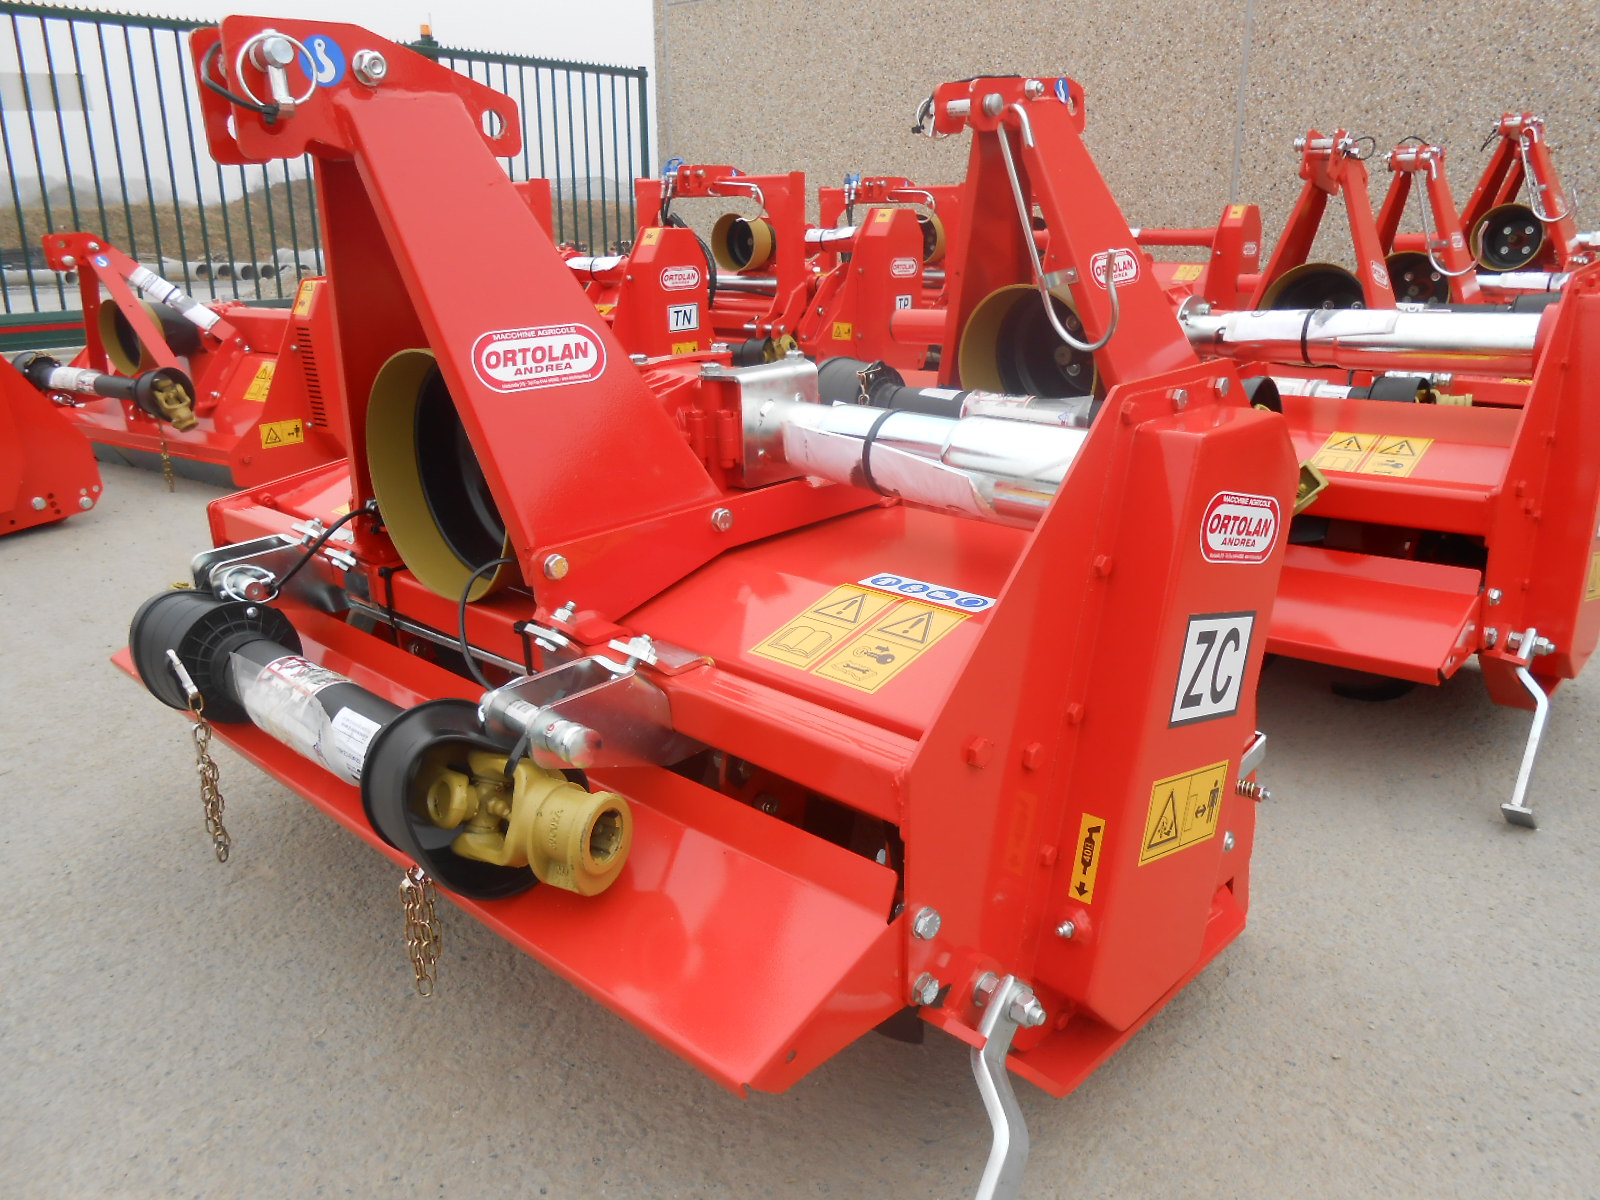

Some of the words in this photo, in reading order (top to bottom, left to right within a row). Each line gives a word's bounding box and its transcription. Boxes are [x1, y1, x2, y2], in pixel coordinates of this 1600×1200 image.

[663, 273, 696, 282] ORTOLAN
[898, 297, 909, 310] TP
[673, 309, 692, 327] TN
[492, 329, 537, 341] MACCHINE
[537, 326, 577, 337] AGRICOLE
[485, 341, 589, 370] ORTOLAN
[514, 362, 573, 376] ANDREA
[1209, 513, 1273, 538] ORTOLAN
[1220, 537, 1256, 548] ANDREA
[1180, 627, 1240, 710] ZC
